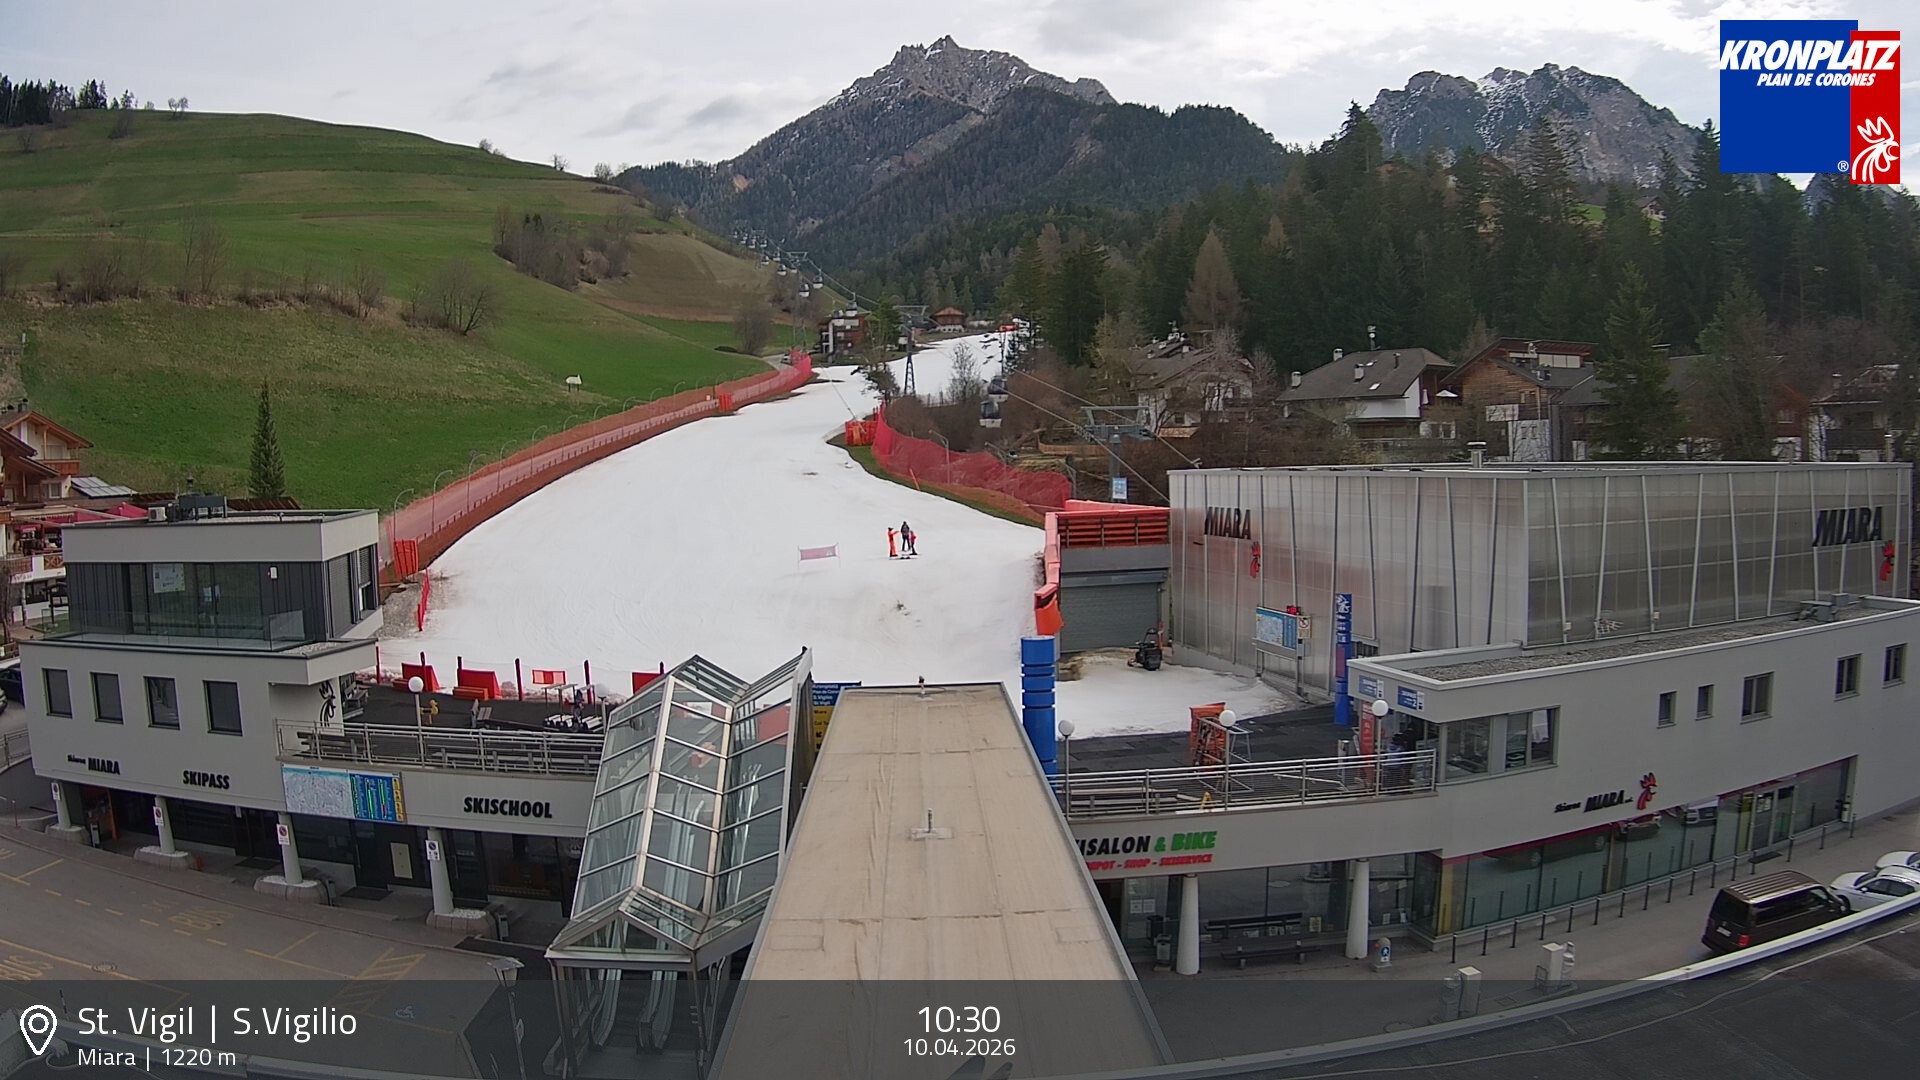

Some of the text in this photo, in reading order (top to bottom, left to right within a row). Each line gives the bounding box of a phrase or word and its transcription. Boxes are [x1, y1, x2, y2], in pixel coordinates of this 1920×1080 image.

[1204, 506, 1251, 540] MIARA
[1812, 506, 1882, 547] MIARA
[88, 757, 121, 775] MIARA
[182, 770, 230, 790] SKIPASS
[463, 796, 553, 819] SKISCHOOL
[1584, 790, 1625, 813] MIARA
[1075, 831, 1217, 857] ISALON & BIKE
